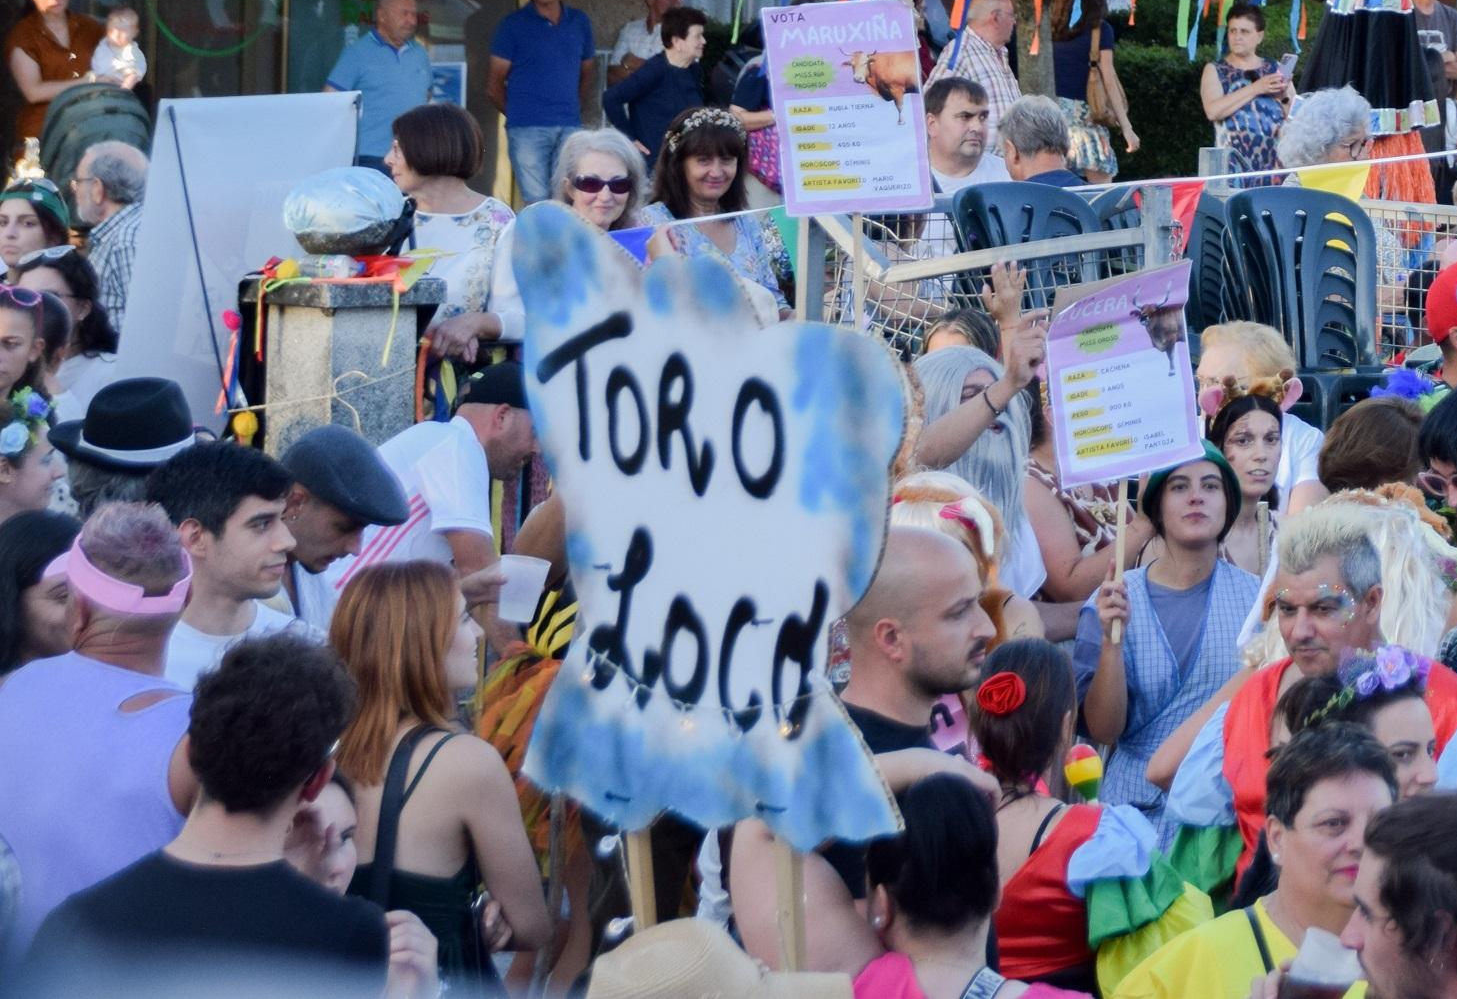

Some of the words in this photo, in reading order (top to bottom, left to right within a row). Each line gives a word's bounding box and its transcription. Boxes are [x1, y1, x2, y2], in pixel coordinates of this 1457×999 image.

[770, 12, 806, 24] VOTA
[780, 12, 903, 49] MARUXIÑA
[791, 59, 825, 68] CANDIDATA
[802, 179, 832, 187] ARTISTA
[833, 177, 867, 185] FAVORITO
[873, 183, 912, 192] VAQUERIZO
[1079, 338, 1098, 348] MISS
[1098, 335, 1120, 345] OROSO
[1067, 372, 1086, 381] RAZA
[1100, 363, 1131, 375] CACHENA
[1070, 390, 1089, 400] IDADE
[536, 309, 786, 501] TORO
[1071, 410, 1089, 420] PESO
[1076, 444, 1105, 456] ARTISTA
[1105, 436, 1138, 449] FAVORITO
[1143, 430, 1166, 440] ISABEL
[1144, 438, 1175, 450] PANTOJA
